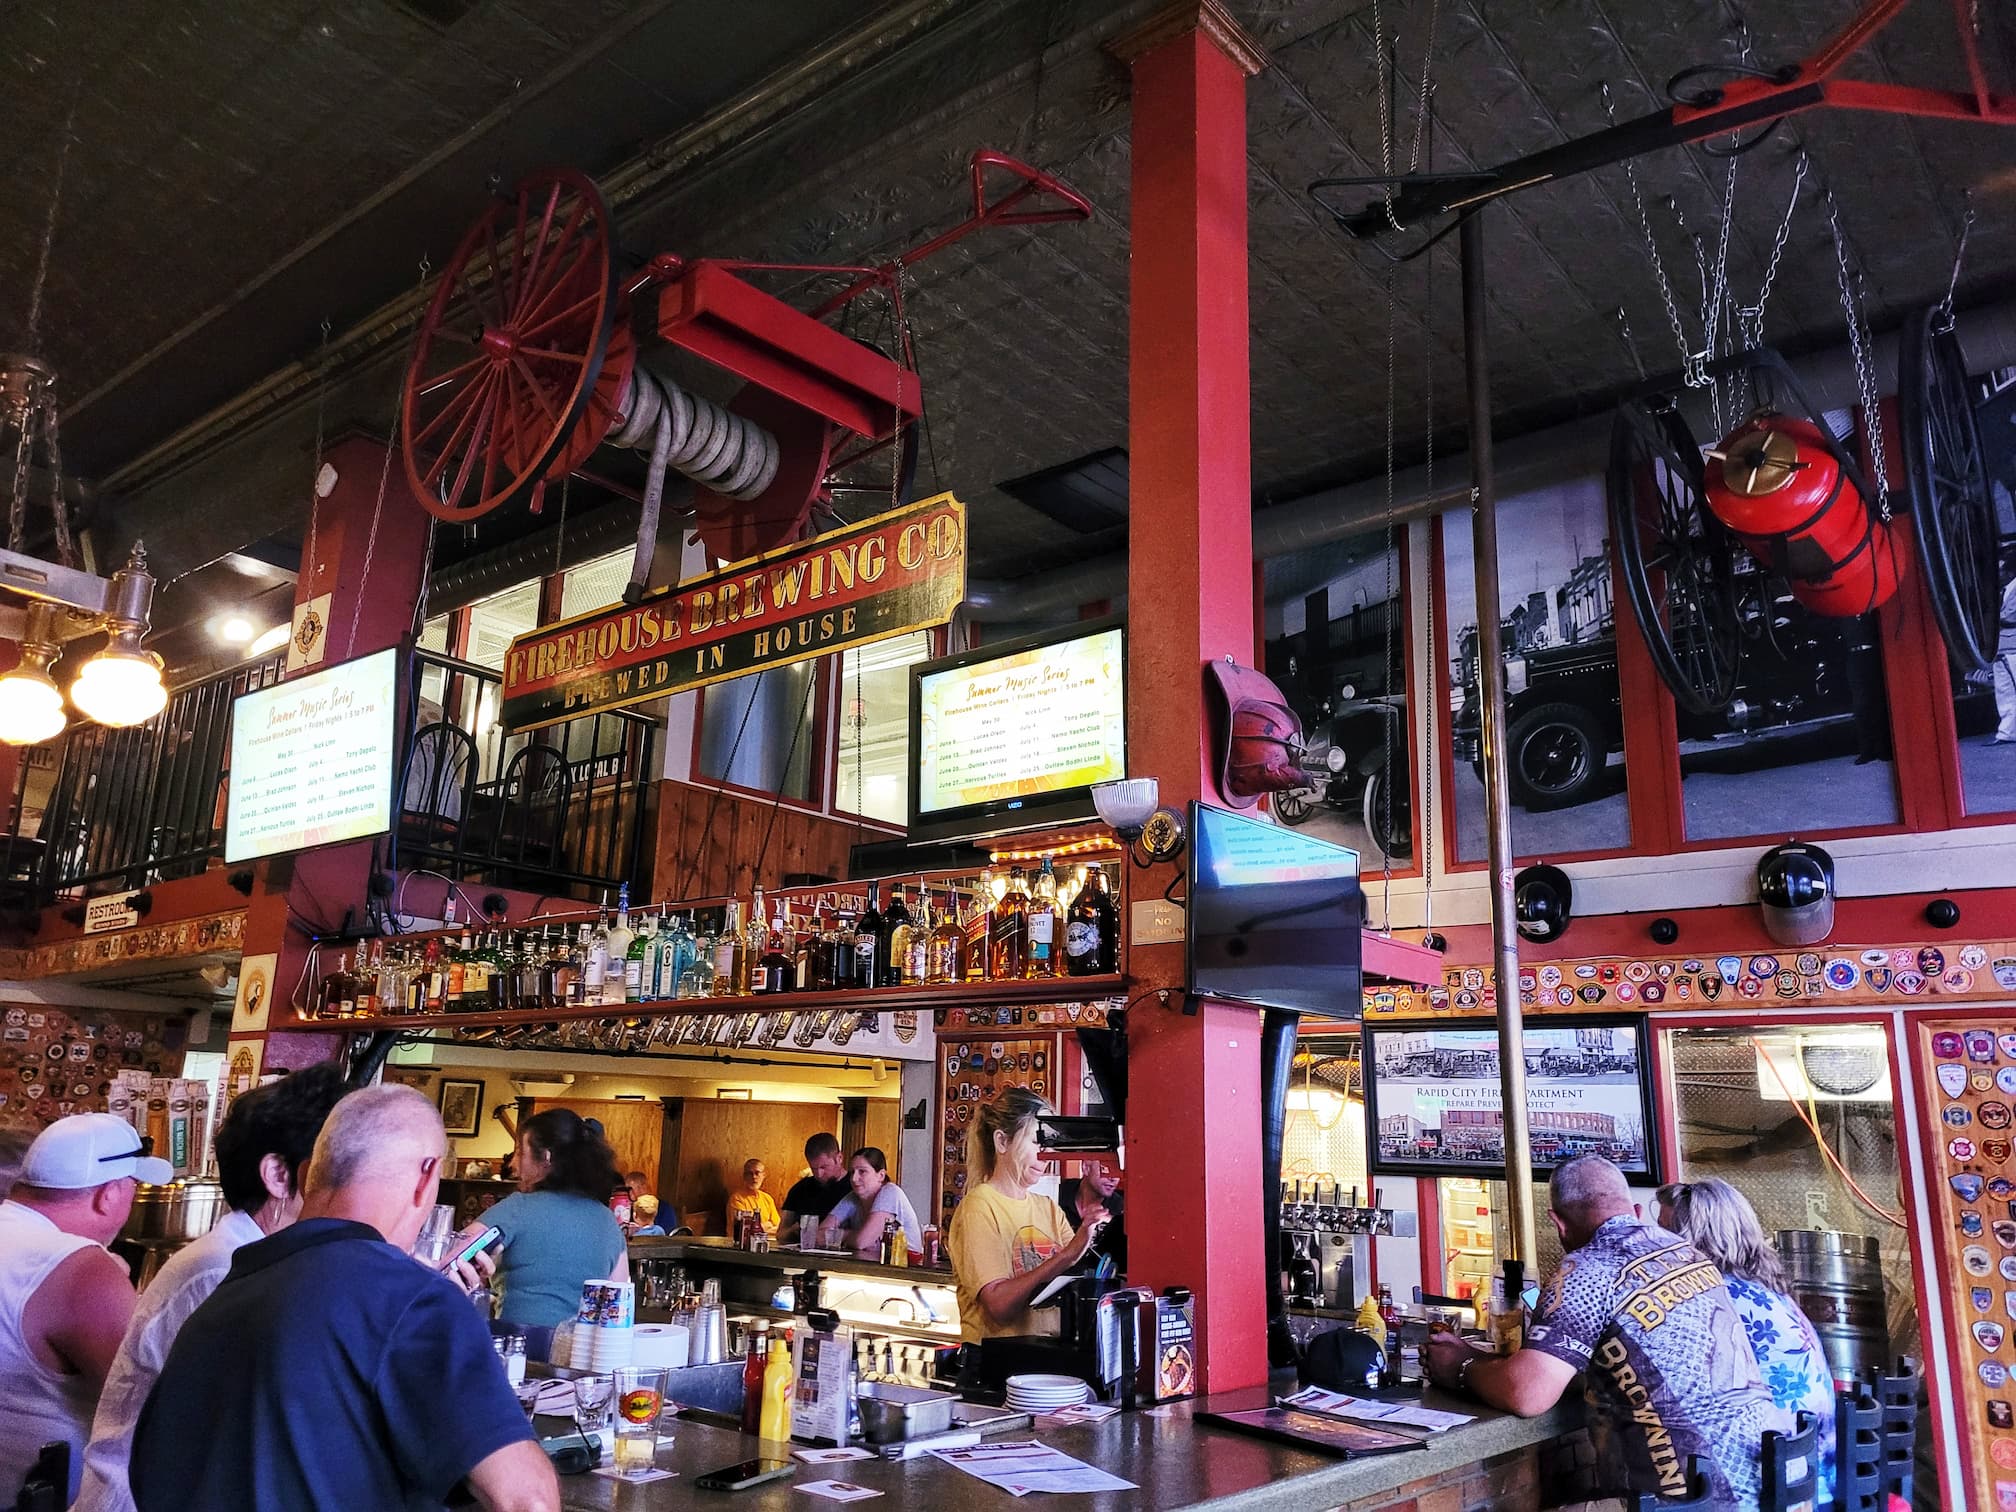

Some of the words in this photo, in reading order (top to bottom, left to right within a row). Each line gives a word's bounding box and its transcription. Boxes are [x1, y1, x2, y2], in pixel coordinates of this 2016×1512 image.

[508, 600, 683, 688] FIREHOUSE
[690, 536, 886, 634] BREWING
[696, 643, 726, 674] IN
[966, 682, 1002, 701] Summer
[1005, 676, 1038, 691] Music
[1041, 665, 1070, 684] Series
[1084, 677, 1095, 685] PM
[267, 706, 297, 729] Summer
[300, 699, 327, 718] Music
[330, 687, 354, 710] Series
[88, 901, 133, 920] RESTROO
[1154, 917, 1172, 926] NO
[1417, 1087, 1448, 1097] RAPID
[1452, 1087, 1477, 1097] CITY
[1481, 1087, 1503, 1098] FIR
[1526, 1101, 1555, 1109] OTECT
